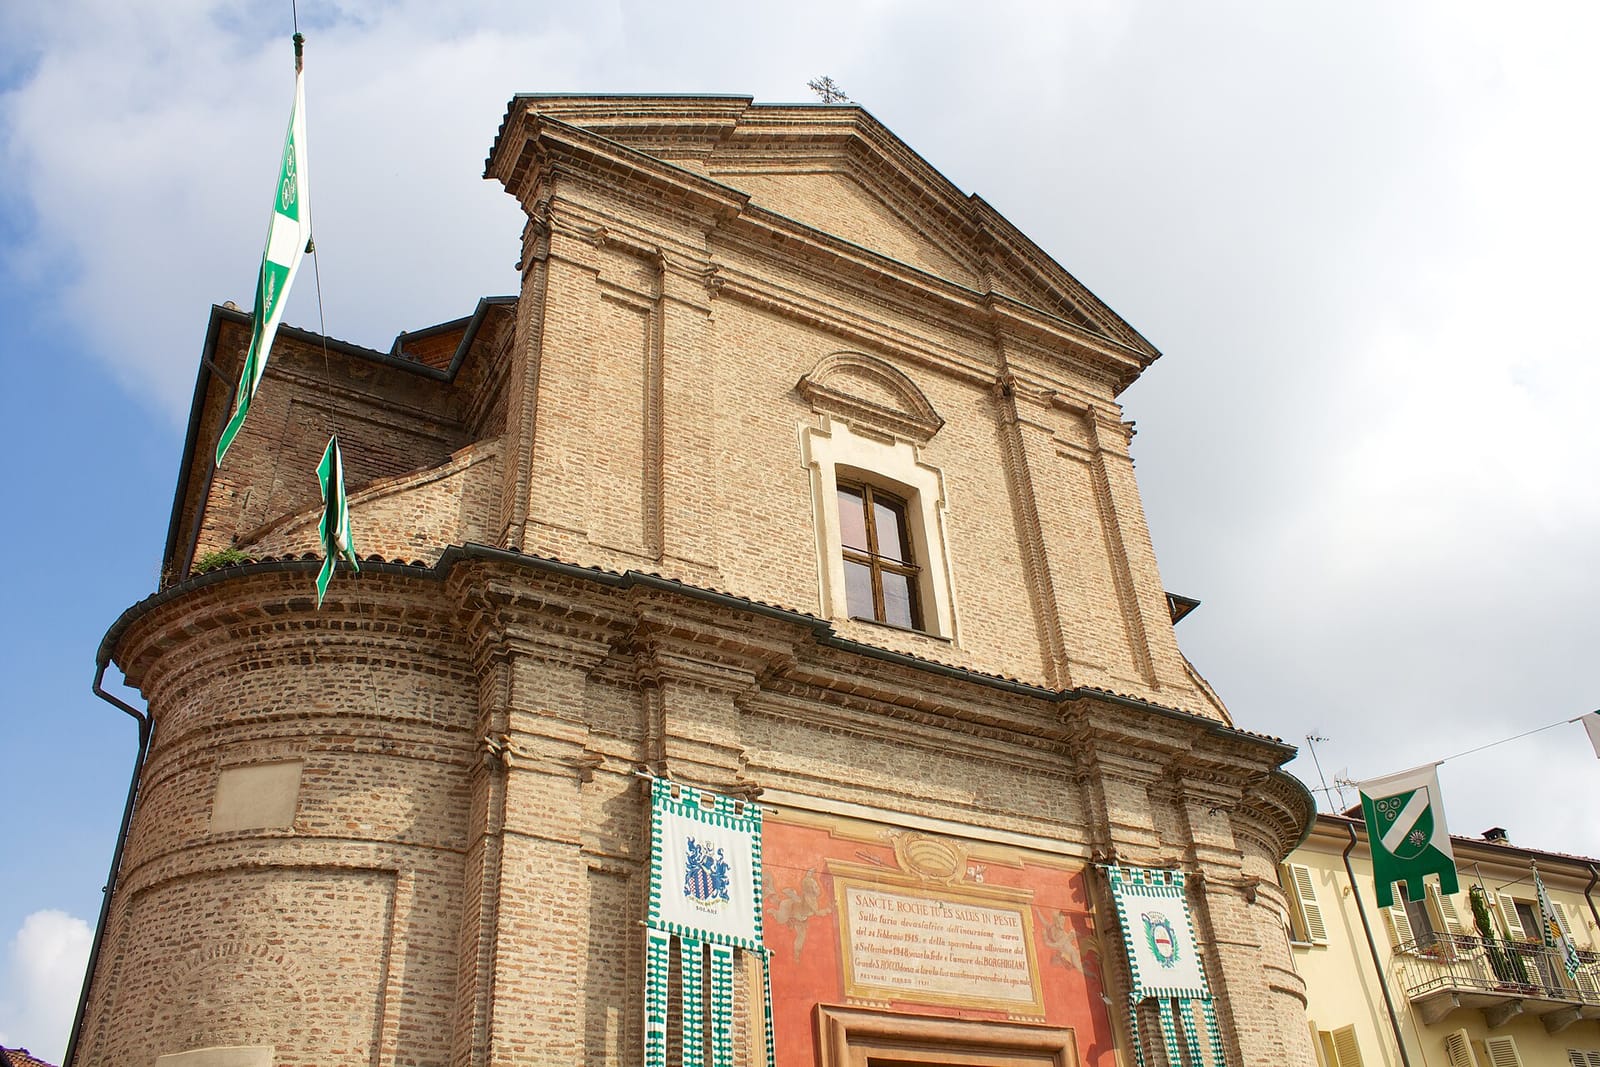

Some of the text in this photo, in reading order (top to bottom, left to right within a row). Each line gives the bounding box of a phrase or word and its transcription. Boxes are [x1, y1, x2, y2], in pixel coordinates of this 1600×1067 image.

[856, 895, 1017, 927] SANCTE ROCHE TU ES SALUS IN PESTE
[879, 915, 897, 925] furia
[901, 917, 943, 931] devastatrice
[947, 923, 994, 938] dell'incursione
[856, 926, 867, 935] del
[929, 936, 945, 945] della
[984, 944, 1012, 953] alluvione
[1014, 946, 1024, 954] del
[859, 943, 892, 955] Settembre
[930, 951, 943, 960] fede
